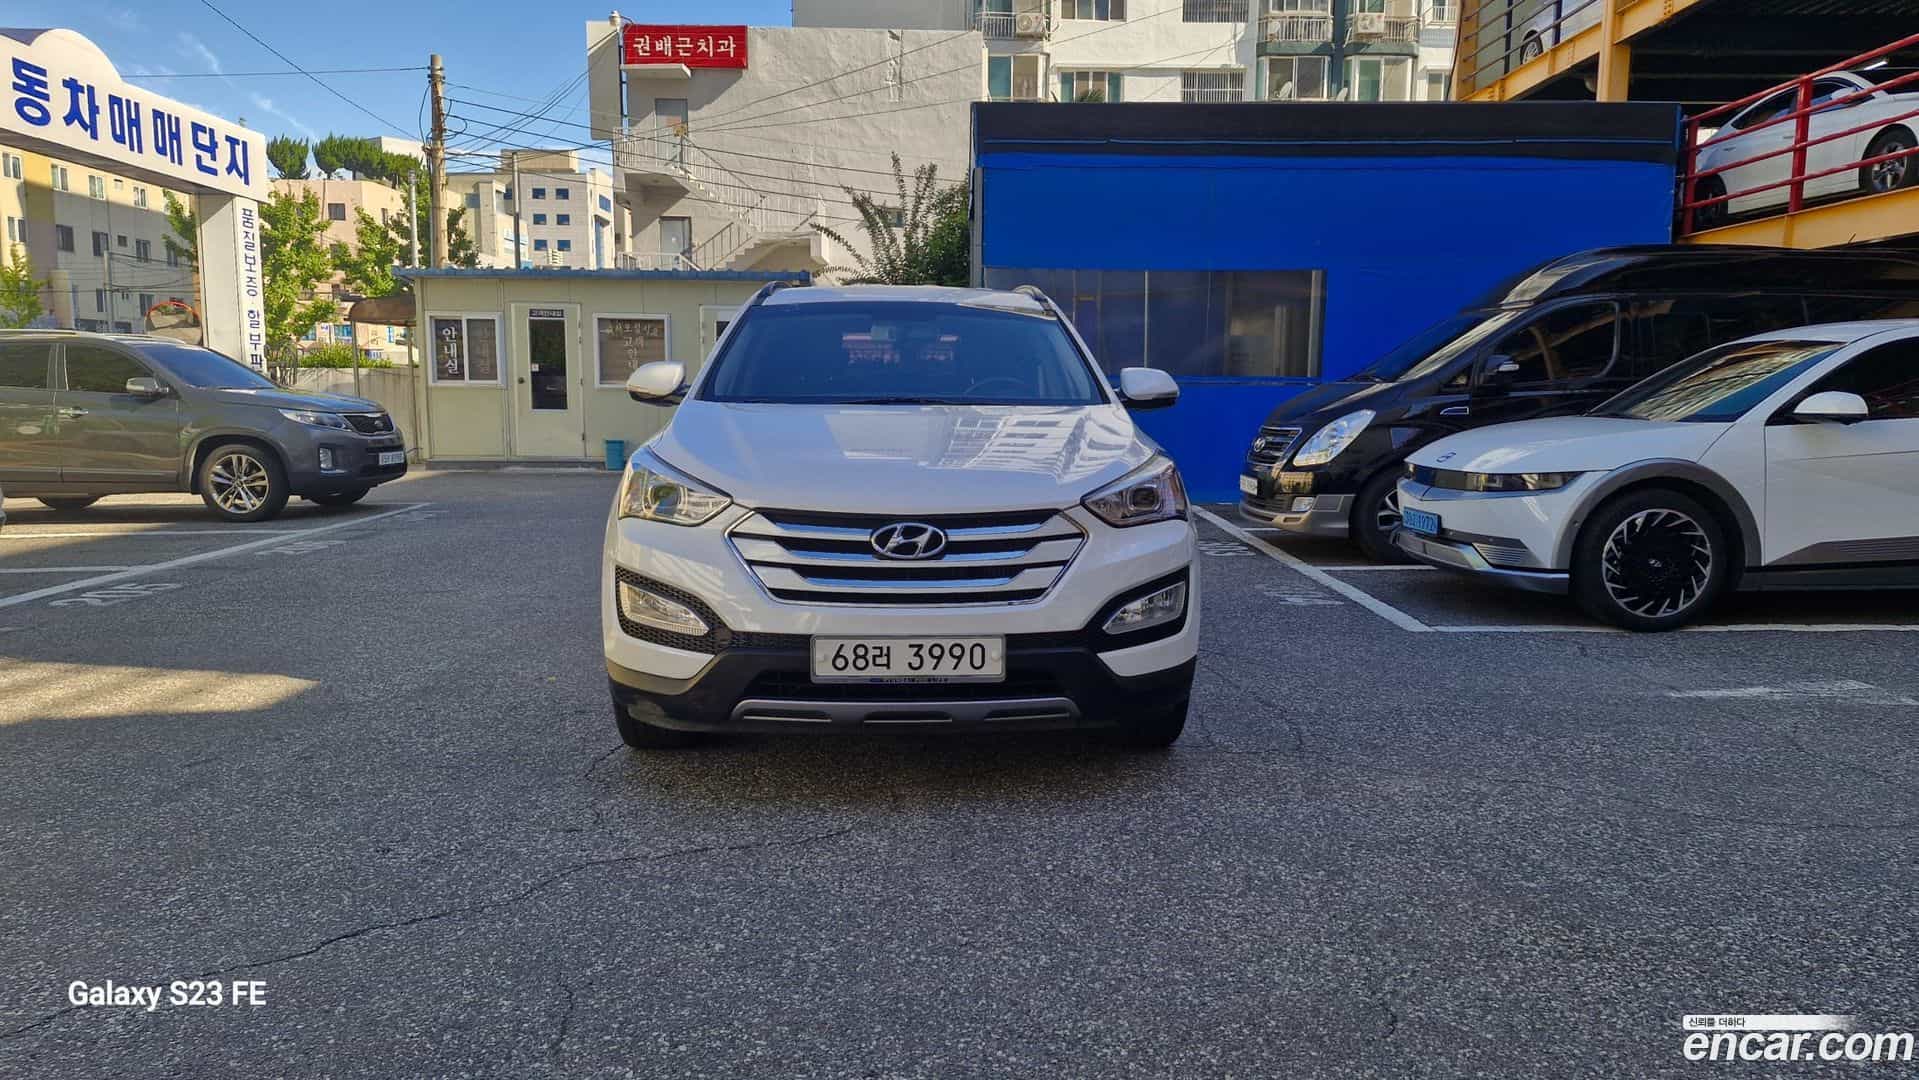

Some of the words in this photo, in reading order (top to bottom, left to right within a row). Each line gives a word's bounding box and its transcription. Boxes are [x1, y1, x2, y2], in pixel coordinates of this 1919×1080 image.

[633, 35, 736, 57] 권배근치과
[242, 207, 258, 297] 품질보증
[442, 326, 459, 374] 안내실
[831, 642, 892, 672] 68러
[907, 642, 986, 671] 3990
